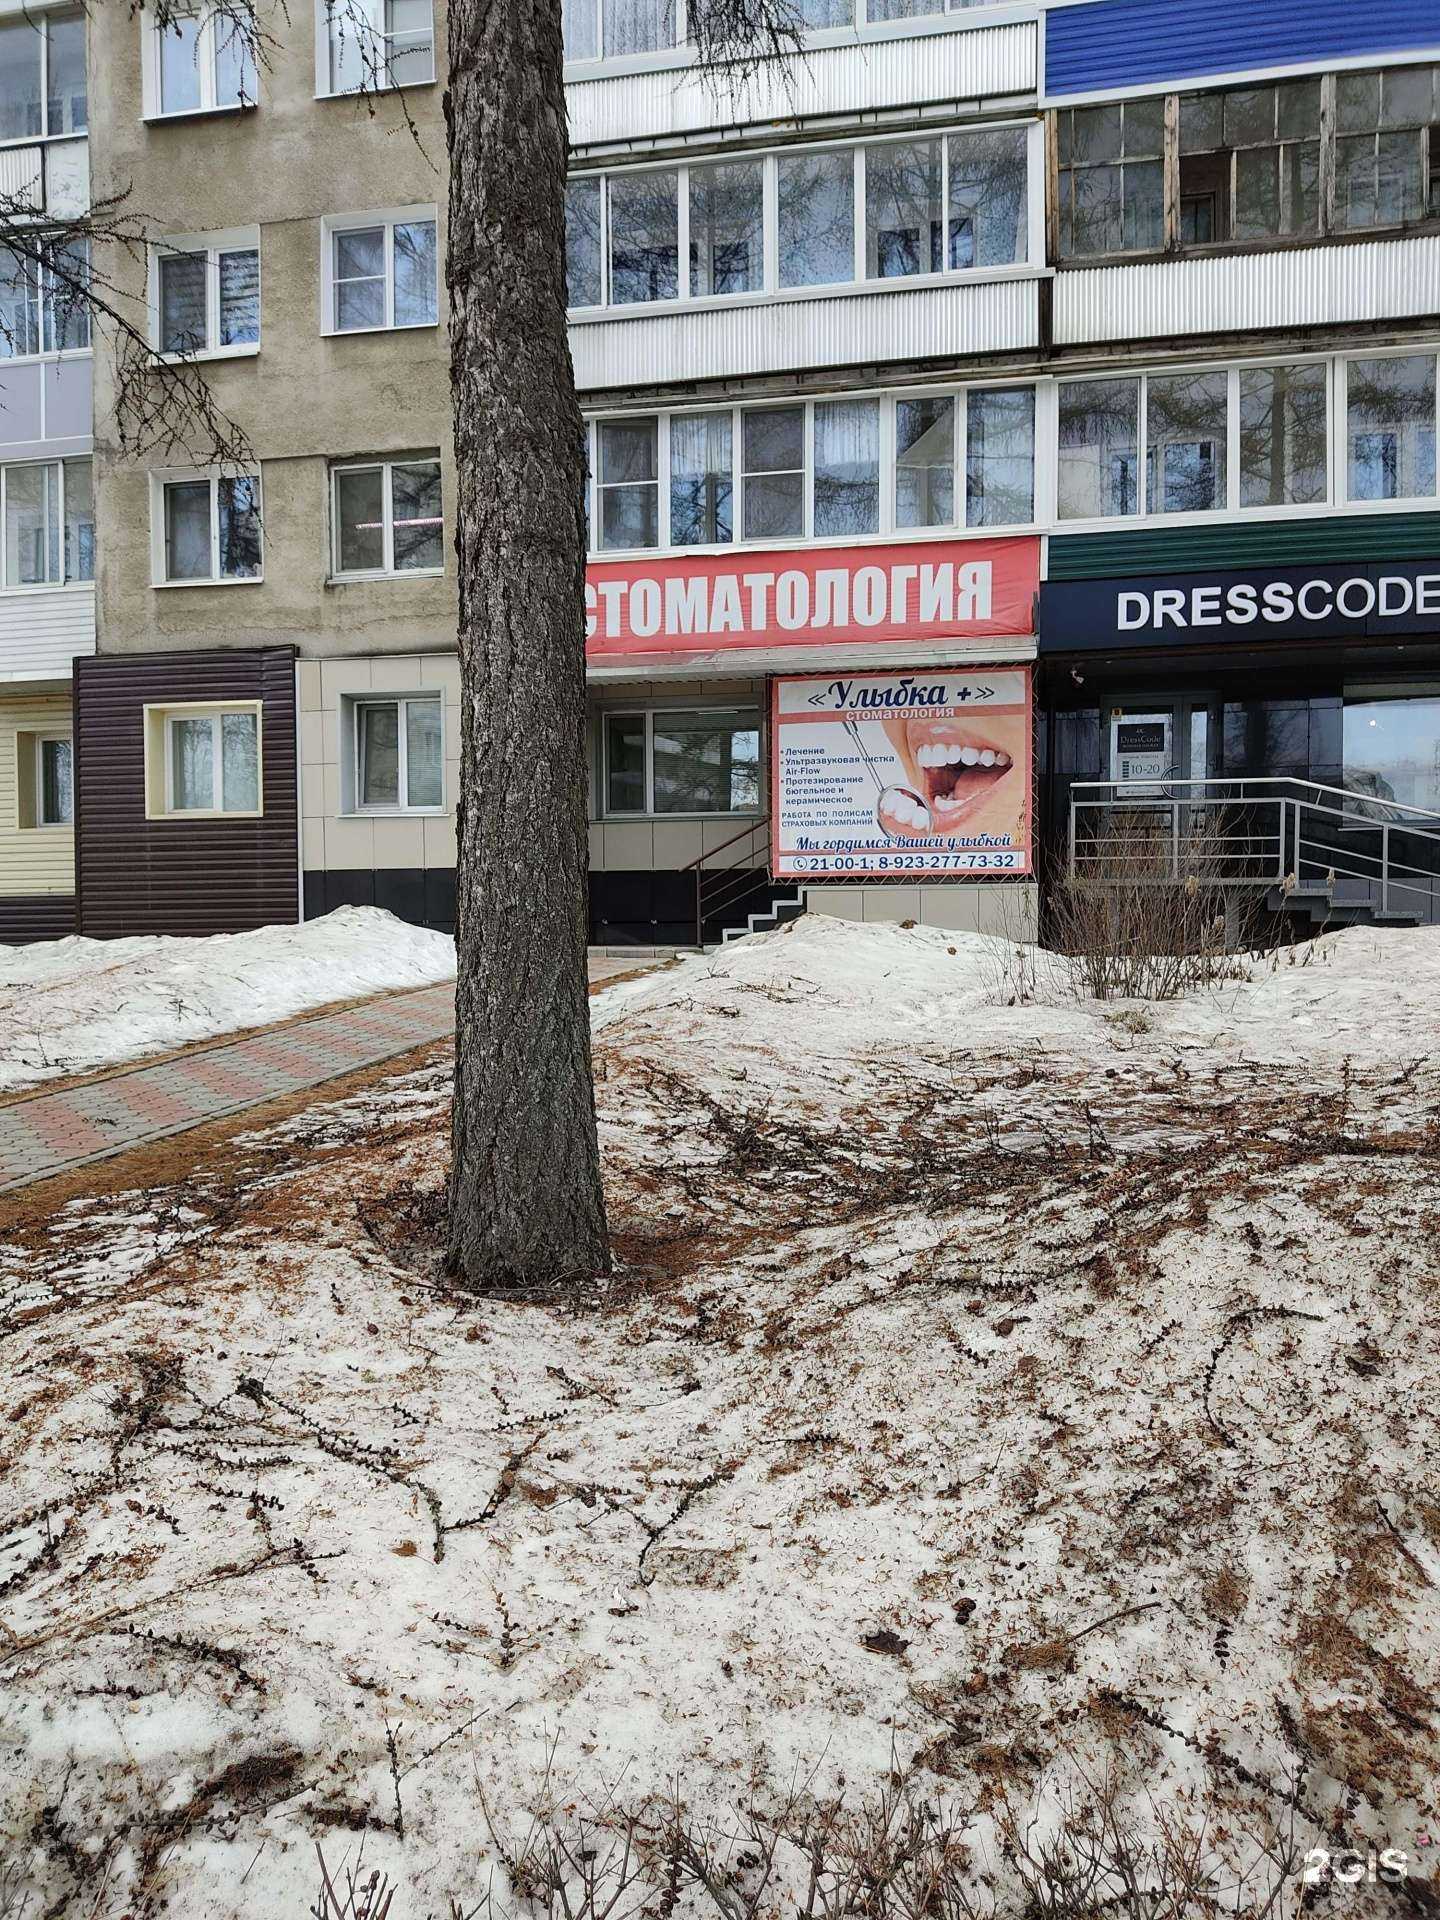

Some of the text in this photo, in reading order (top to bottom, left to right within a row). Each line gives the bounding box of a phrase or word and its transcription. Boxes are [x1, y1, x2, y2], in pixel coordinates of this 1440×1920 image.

[1117, 574, 1440, 631] DRESSCODE
[785, 757, 860, 766] Ультразвуковая
[785, 767, 821, 776] Air-Flow
[1131, 763, 1160, 775] 10-20
[785, 775, 864, 786] Протезирование
[785, 786, 836, 795] бюгельное
[785, 796, 853, 806] керамическое
[781, 811, 812, 819] РАБОТА
[781, 818, 873, 828] СТРАХОВЫХ КОМПАНИЙ
[797, 833, 1012, 852] Мы гордимся Вашей улыбкой
[810, 854, 1014, 871] 21-00-1; 8-923-277-73-32
